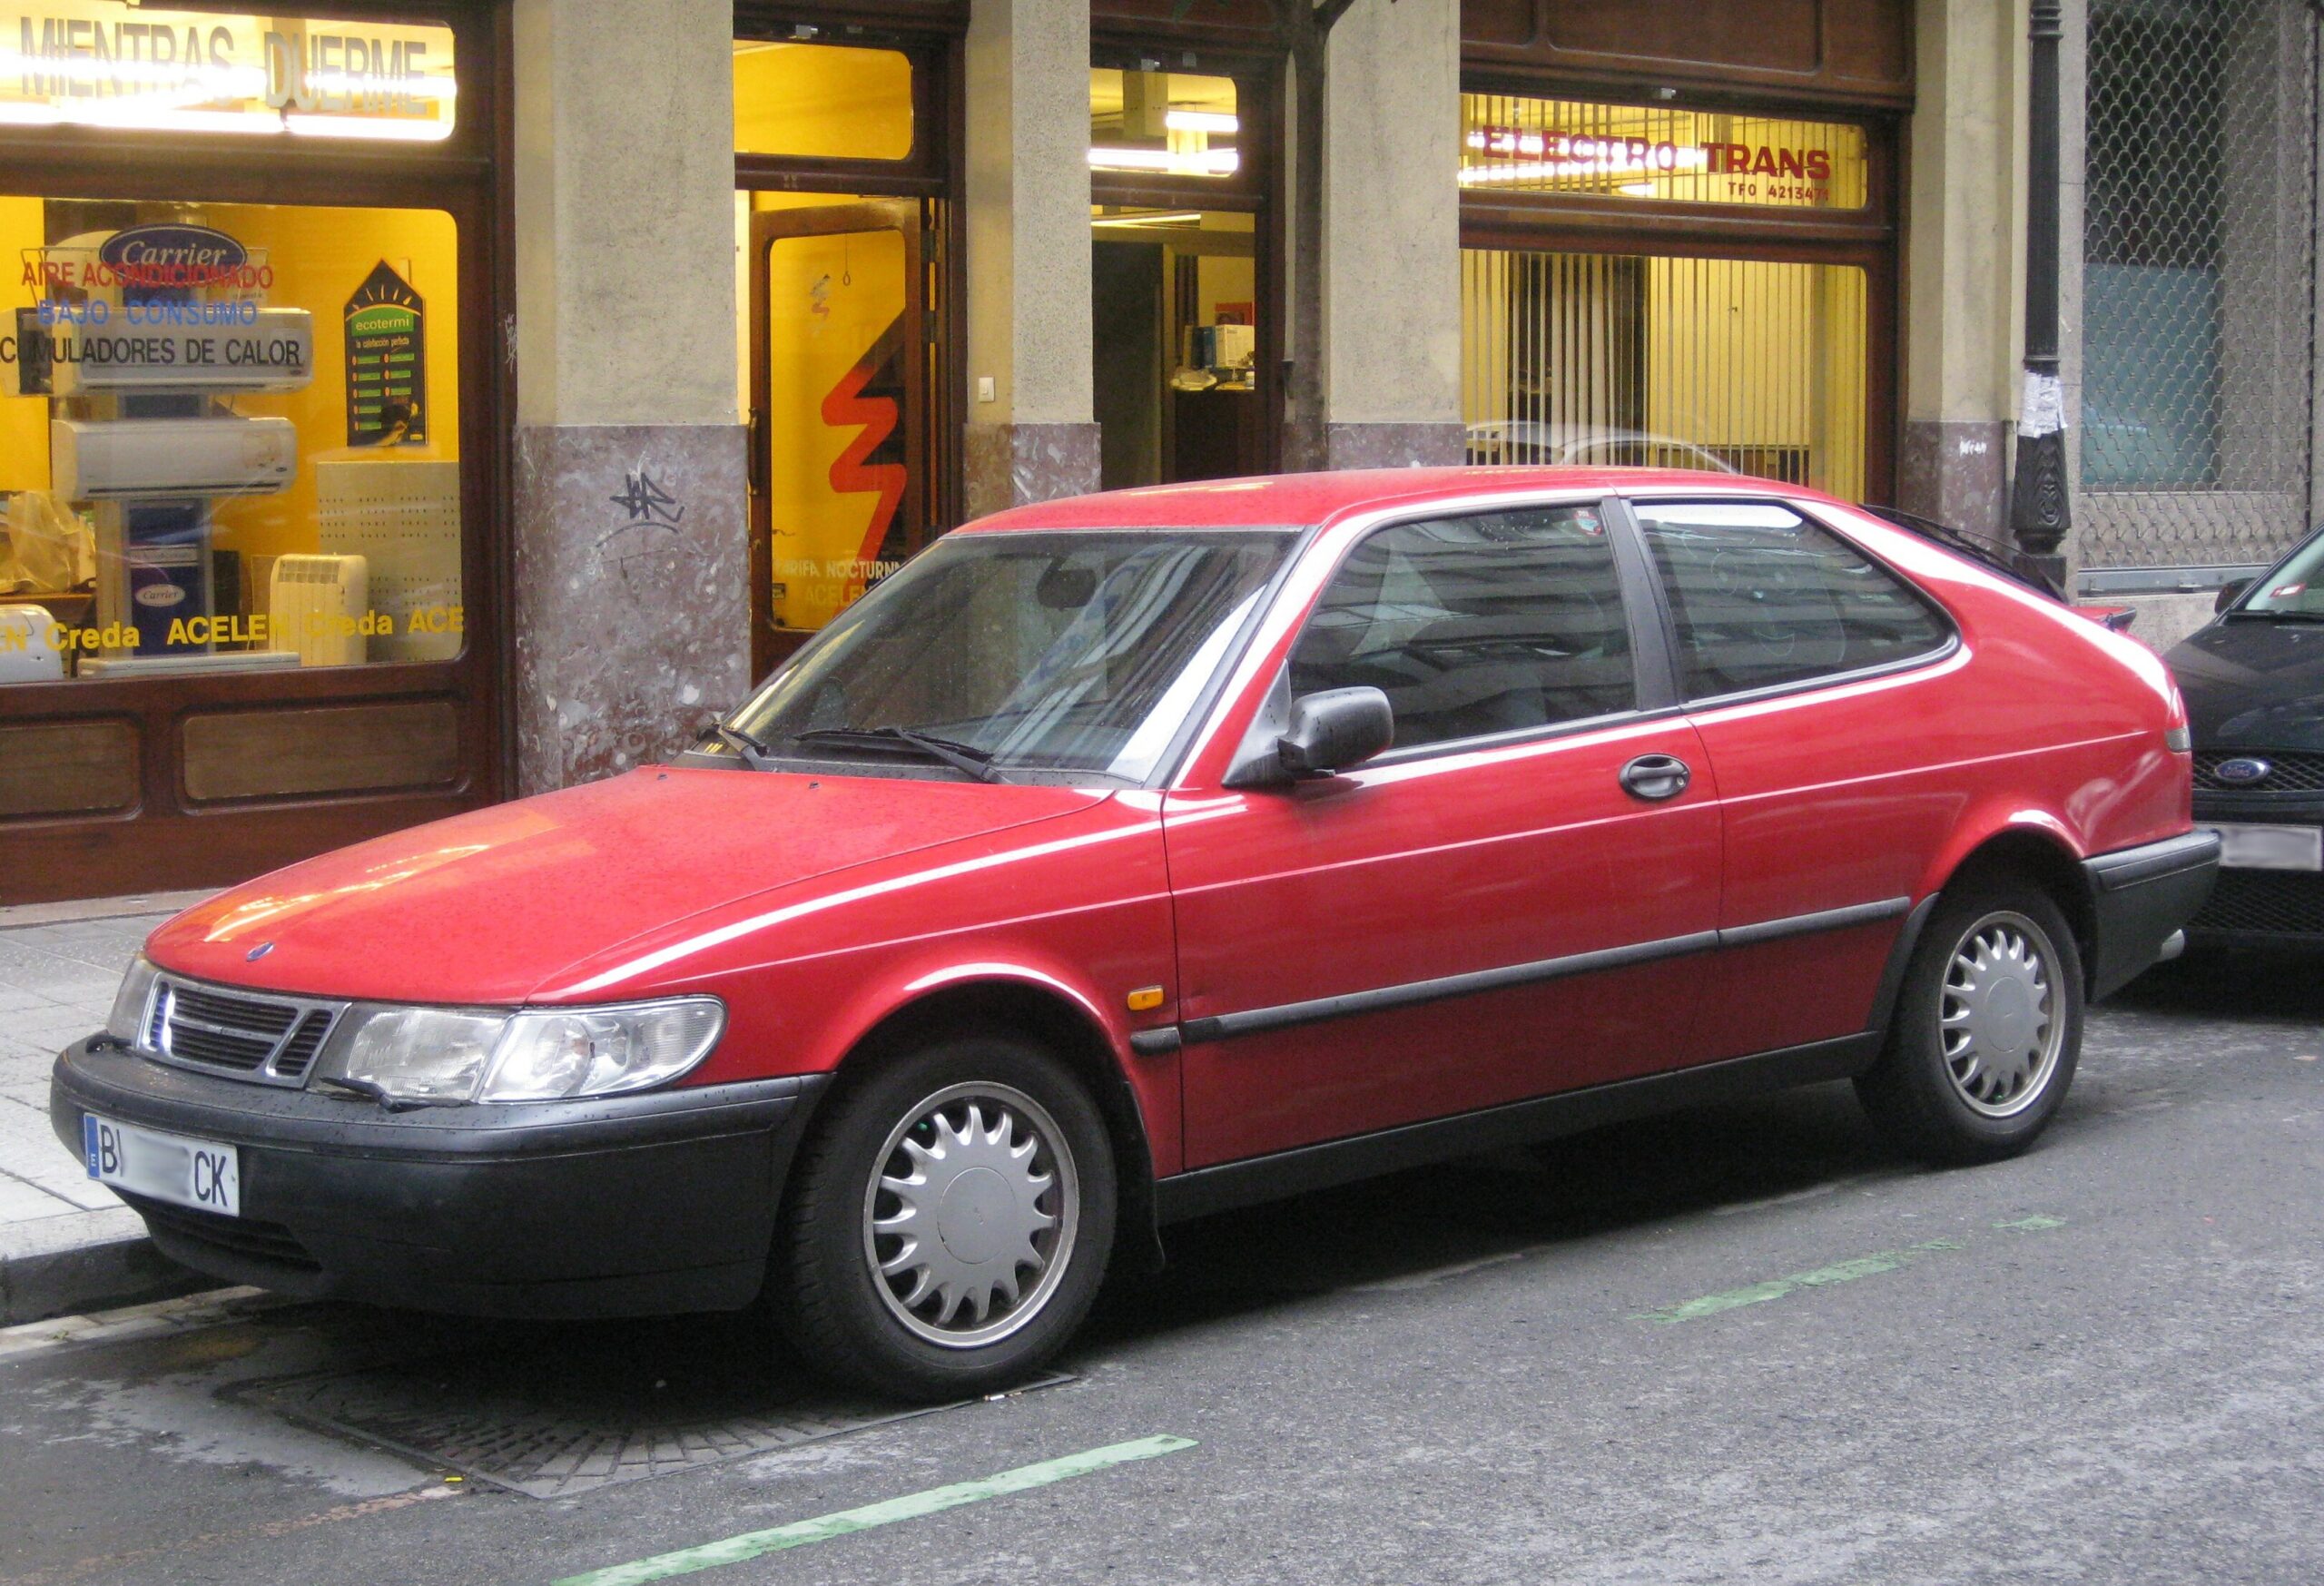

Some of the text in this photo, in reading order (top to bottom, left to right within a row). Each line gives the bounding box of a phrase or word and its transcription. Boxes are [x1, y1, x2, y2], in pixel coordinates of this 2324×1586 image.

[19, 16, 428, 114] MIENTRAS DUERME
[1483, 125, 1831, 181] ELECTRO TRANS
[123, 237, 228, 270] Carrier
[22, 261, 273, 290] AIRE ACONDICIONADO
[38, 298, 258, 327] BAJO CONSUMO
[356, 315, 409, 330] ecotermi
[186, 339, 215, 364] DE
[225, 337, 300, 365] CALOR
[46, 621, 140, 651] Creda
